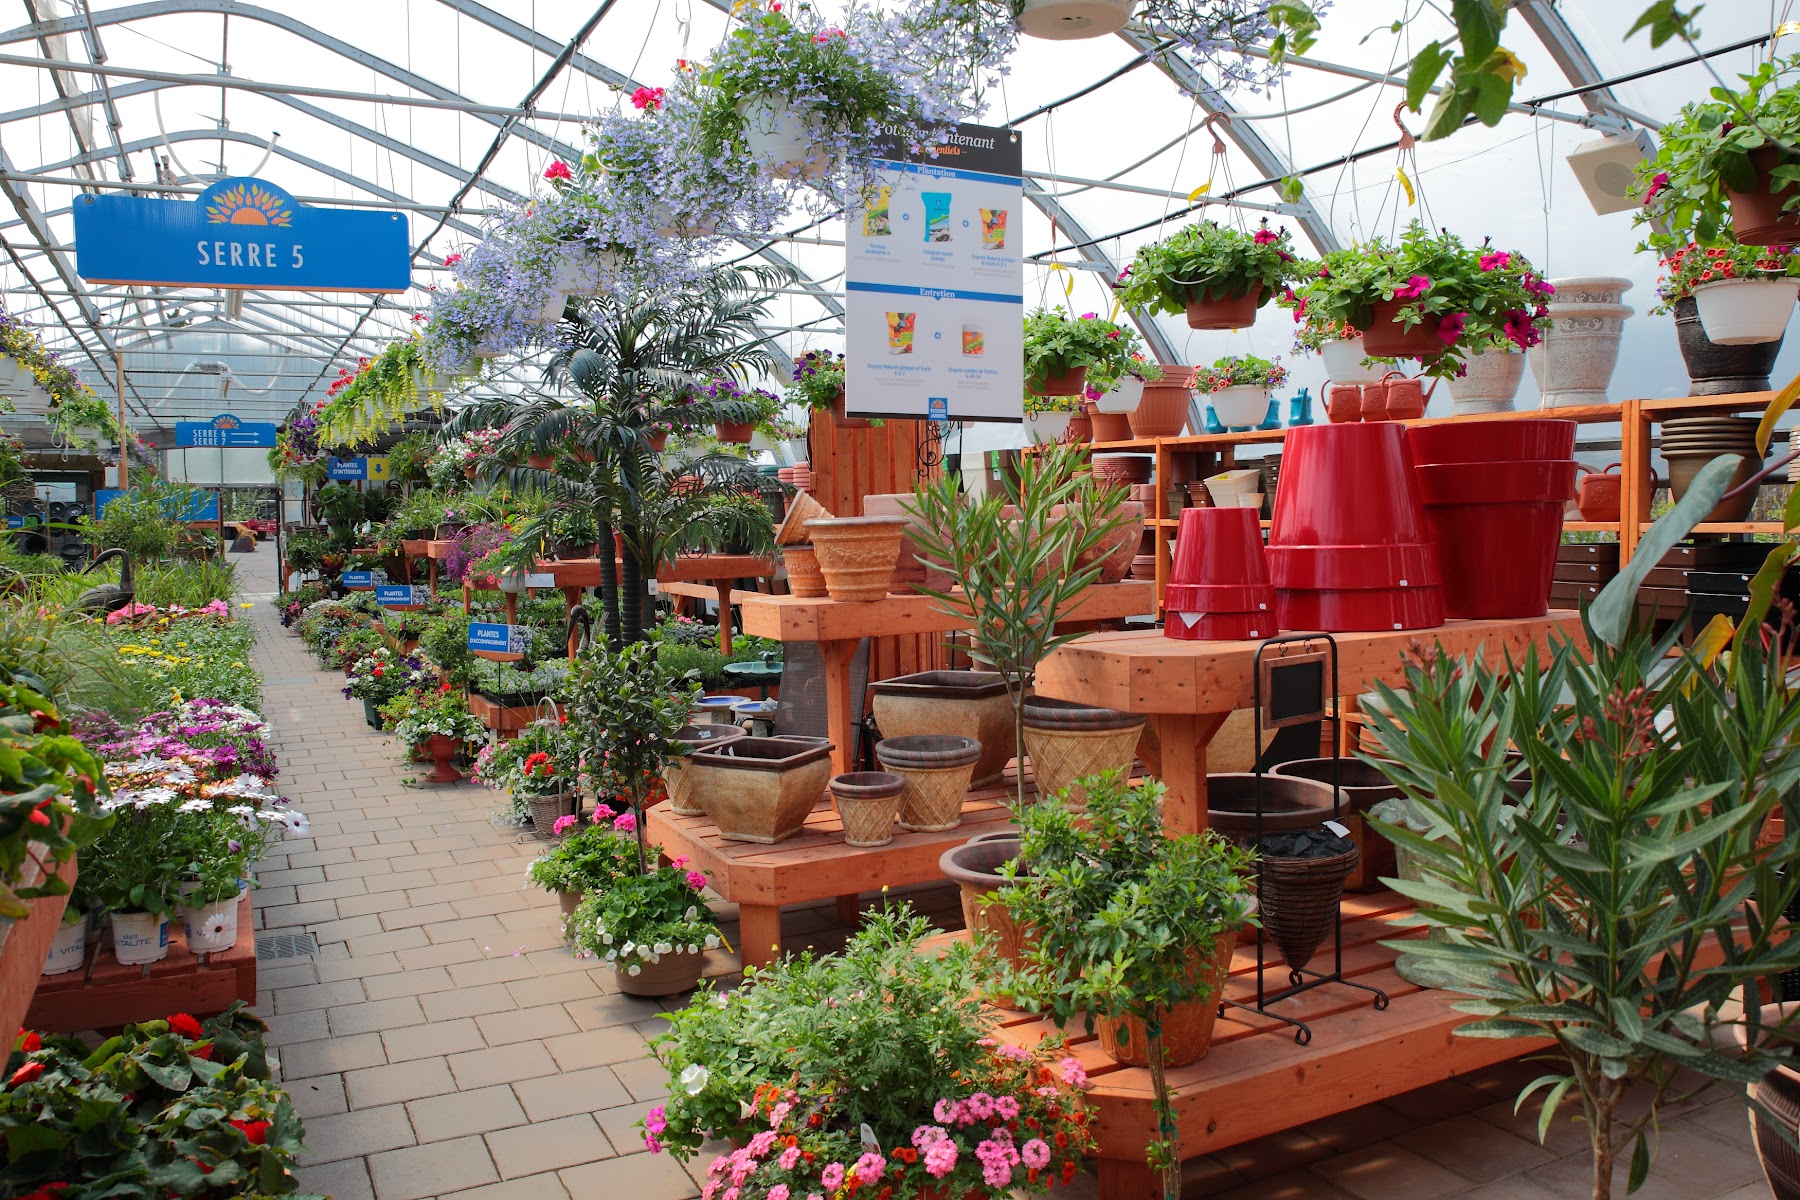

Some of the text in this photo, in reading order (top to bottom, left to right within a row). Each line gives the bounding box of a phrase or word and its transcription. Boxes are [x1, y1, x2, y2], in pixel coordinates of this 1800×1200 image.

[917, 166, 956, 177] Plantation
[197, 240, 304, 269] SERRE 5
[919, 288, 956, 299] Entretien
[192, 429, 227, 438] SERRE 6
[193, 437, 227, 446] SERRE 7
[477, 629, 500, 639] PLANTES
[60, 944, 85, 955] VITAL
